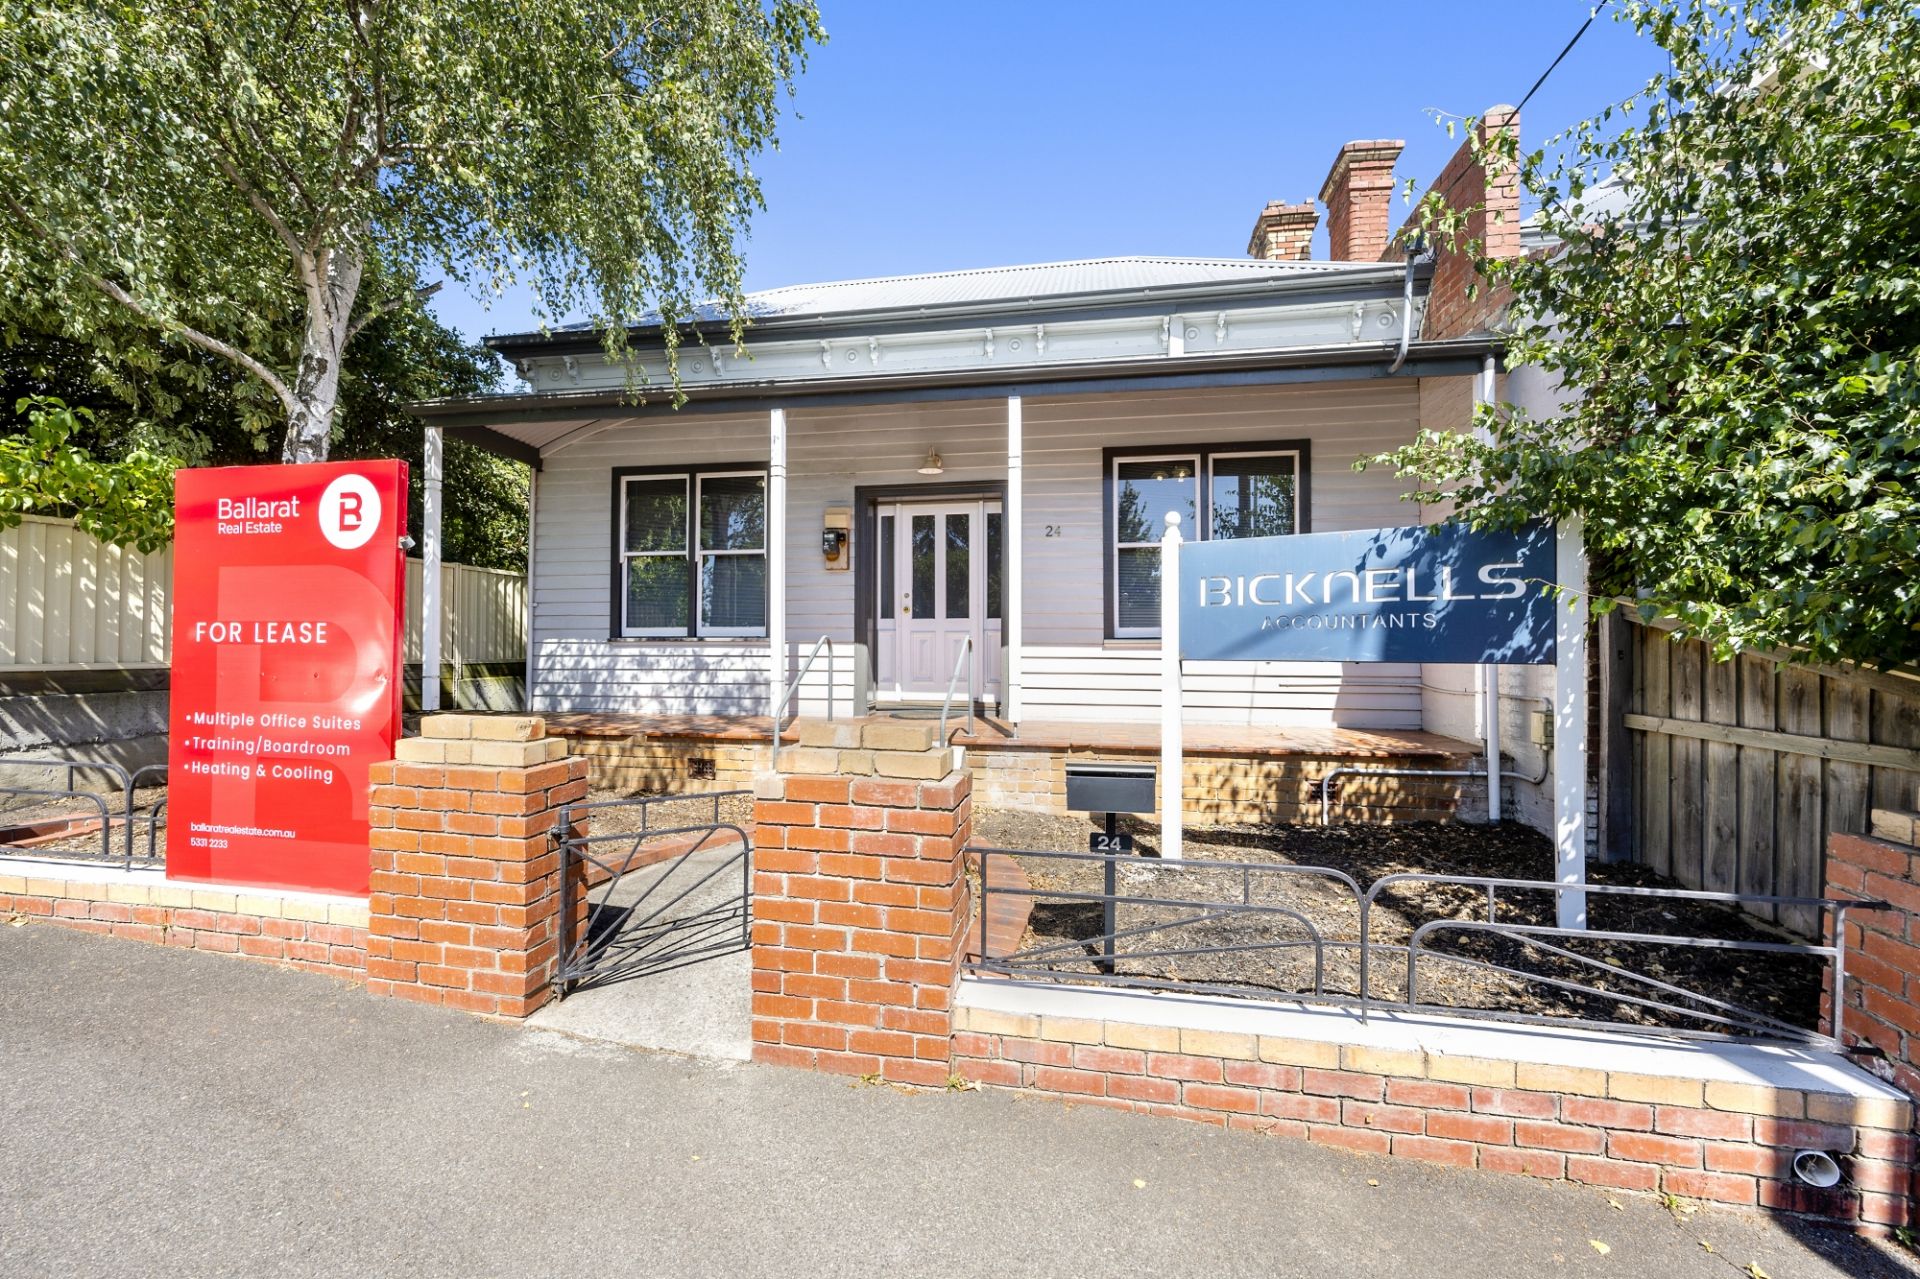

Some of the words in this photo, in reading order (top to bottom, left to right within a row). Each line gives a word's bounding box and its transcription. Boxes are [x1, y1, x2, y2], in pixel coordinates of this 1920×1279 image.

[218, 495, 300, 520] Ballarat
[339, 491, 363, 532] B
[218, 522, 243, 535] Real
[245, 521, 283, 535] Estate
[1045, 525, 1061, 538] 24
[1200, 562, 1527, 608] BICKNELLS
[1261, 613, 1437, 631] ACCOUNTANTS
[195, 621, 242, 644] FOR
[254, 621, 328, 644] LEASE
[193, 711, 255, 730] Multiple
[260, 713, 307, 729] Office
[312, 715, 361, 731] Suites
[192, 735, 351, 756] Training/Boardroom
[191, 761, 251, 780] Heating
[256, 764, 266, 778] &
[272, 764, 333, 785] Cooling
[190, 821, 296, 839] ballaratrealestate.com.au
[1097, 835, 1122, 851] 24
